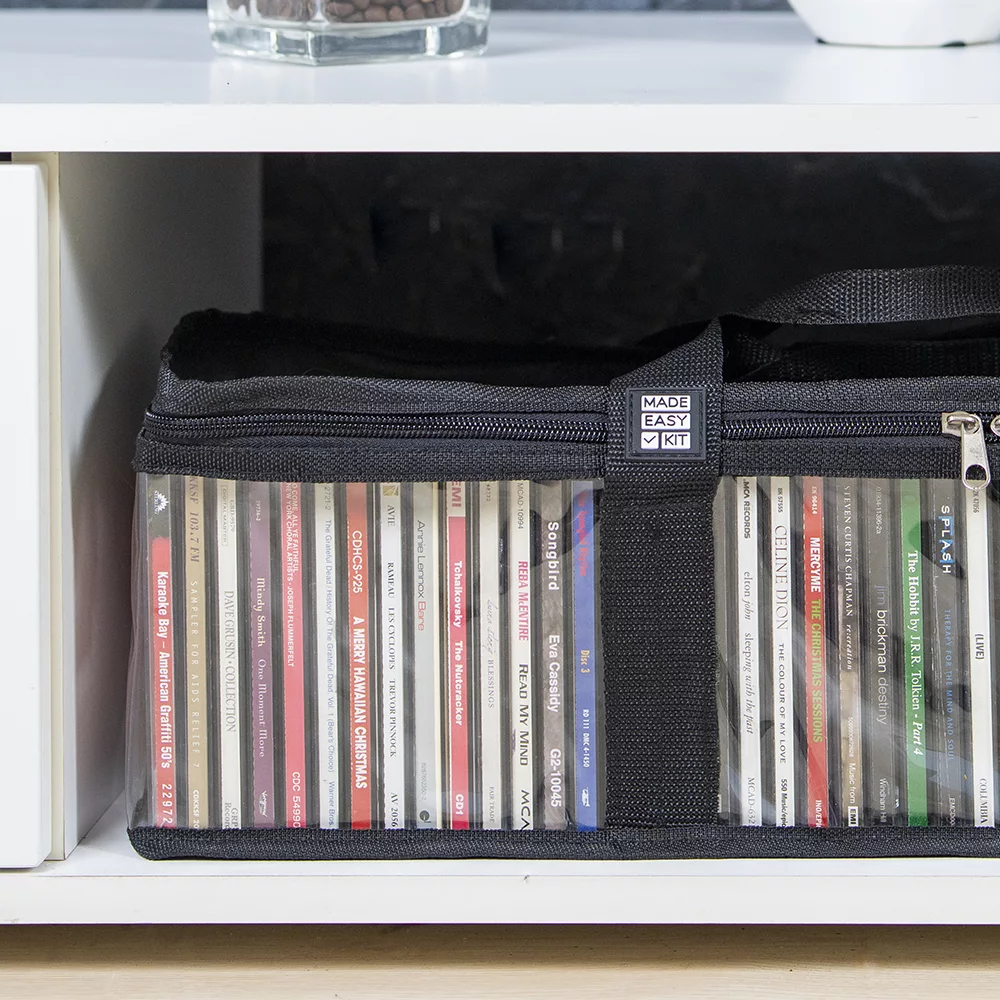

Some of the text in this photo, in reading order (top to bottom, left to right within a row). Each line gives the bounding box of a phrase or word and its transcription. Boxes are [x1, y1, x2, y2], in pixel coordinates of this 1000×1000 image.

[643, 396, 689, 408] MADE
[644, 414, 688, 427] EASY
[663, 433, 688, 446] KIT
[387, 505, 395, 526] AVIE
[190, 547, 199, 562] FM
[844, 526, 852, 567] CURTIS
[325, 590, 333, 614] History
[417, 520, 426, 631] Annie Lennox Bare
[518, 561, 528, 641] REBA McENTIRE
[775, 525, 788, 630] CELINE DION
[907, 552, 919, 632] The Hobbit by
[190, 581, 198, 634] SAMPLER
[546, 521, 560, 712] Songbird Eva Cassidy
[224, 591, 236, 732] DAVE GRUSIN COLLECTION
[326, 643, 334, 672] Grateful
[352, 530, 367, 789] CDHCS-925 A MERRY HAWAIIAN CHRISTMAS
[453, 561, 464, 725] Tchaikovsky The Nutcracker
[580, 650, 589, 665] Disc
[742, 572, 755, 734] elton john sleeping with the past
[811, 538, 822, 742] MERCYME THE CHRISTMAS SESSIONS
[874, 585, 889, 725] jim brickman destiny
[191, 674, 199, 702] AIDS
[253, 578, 267, 757] Mindy Smith One Moment More
[911, 635, 922, 746] J.R.R. Tolkien Part
[156, 572, 172, 824] Karaoke Bay American Graffiti 50's 22972
[327, 719, 335, 742] (Bear's
[292, 772, 300, 791] CDC
[327, 744, 335, 772] Choice)
[550, 749, 561, 807] G2-10045
[455, 794, 464, 815] CD1
[879, 778, 887, 810] Windham
